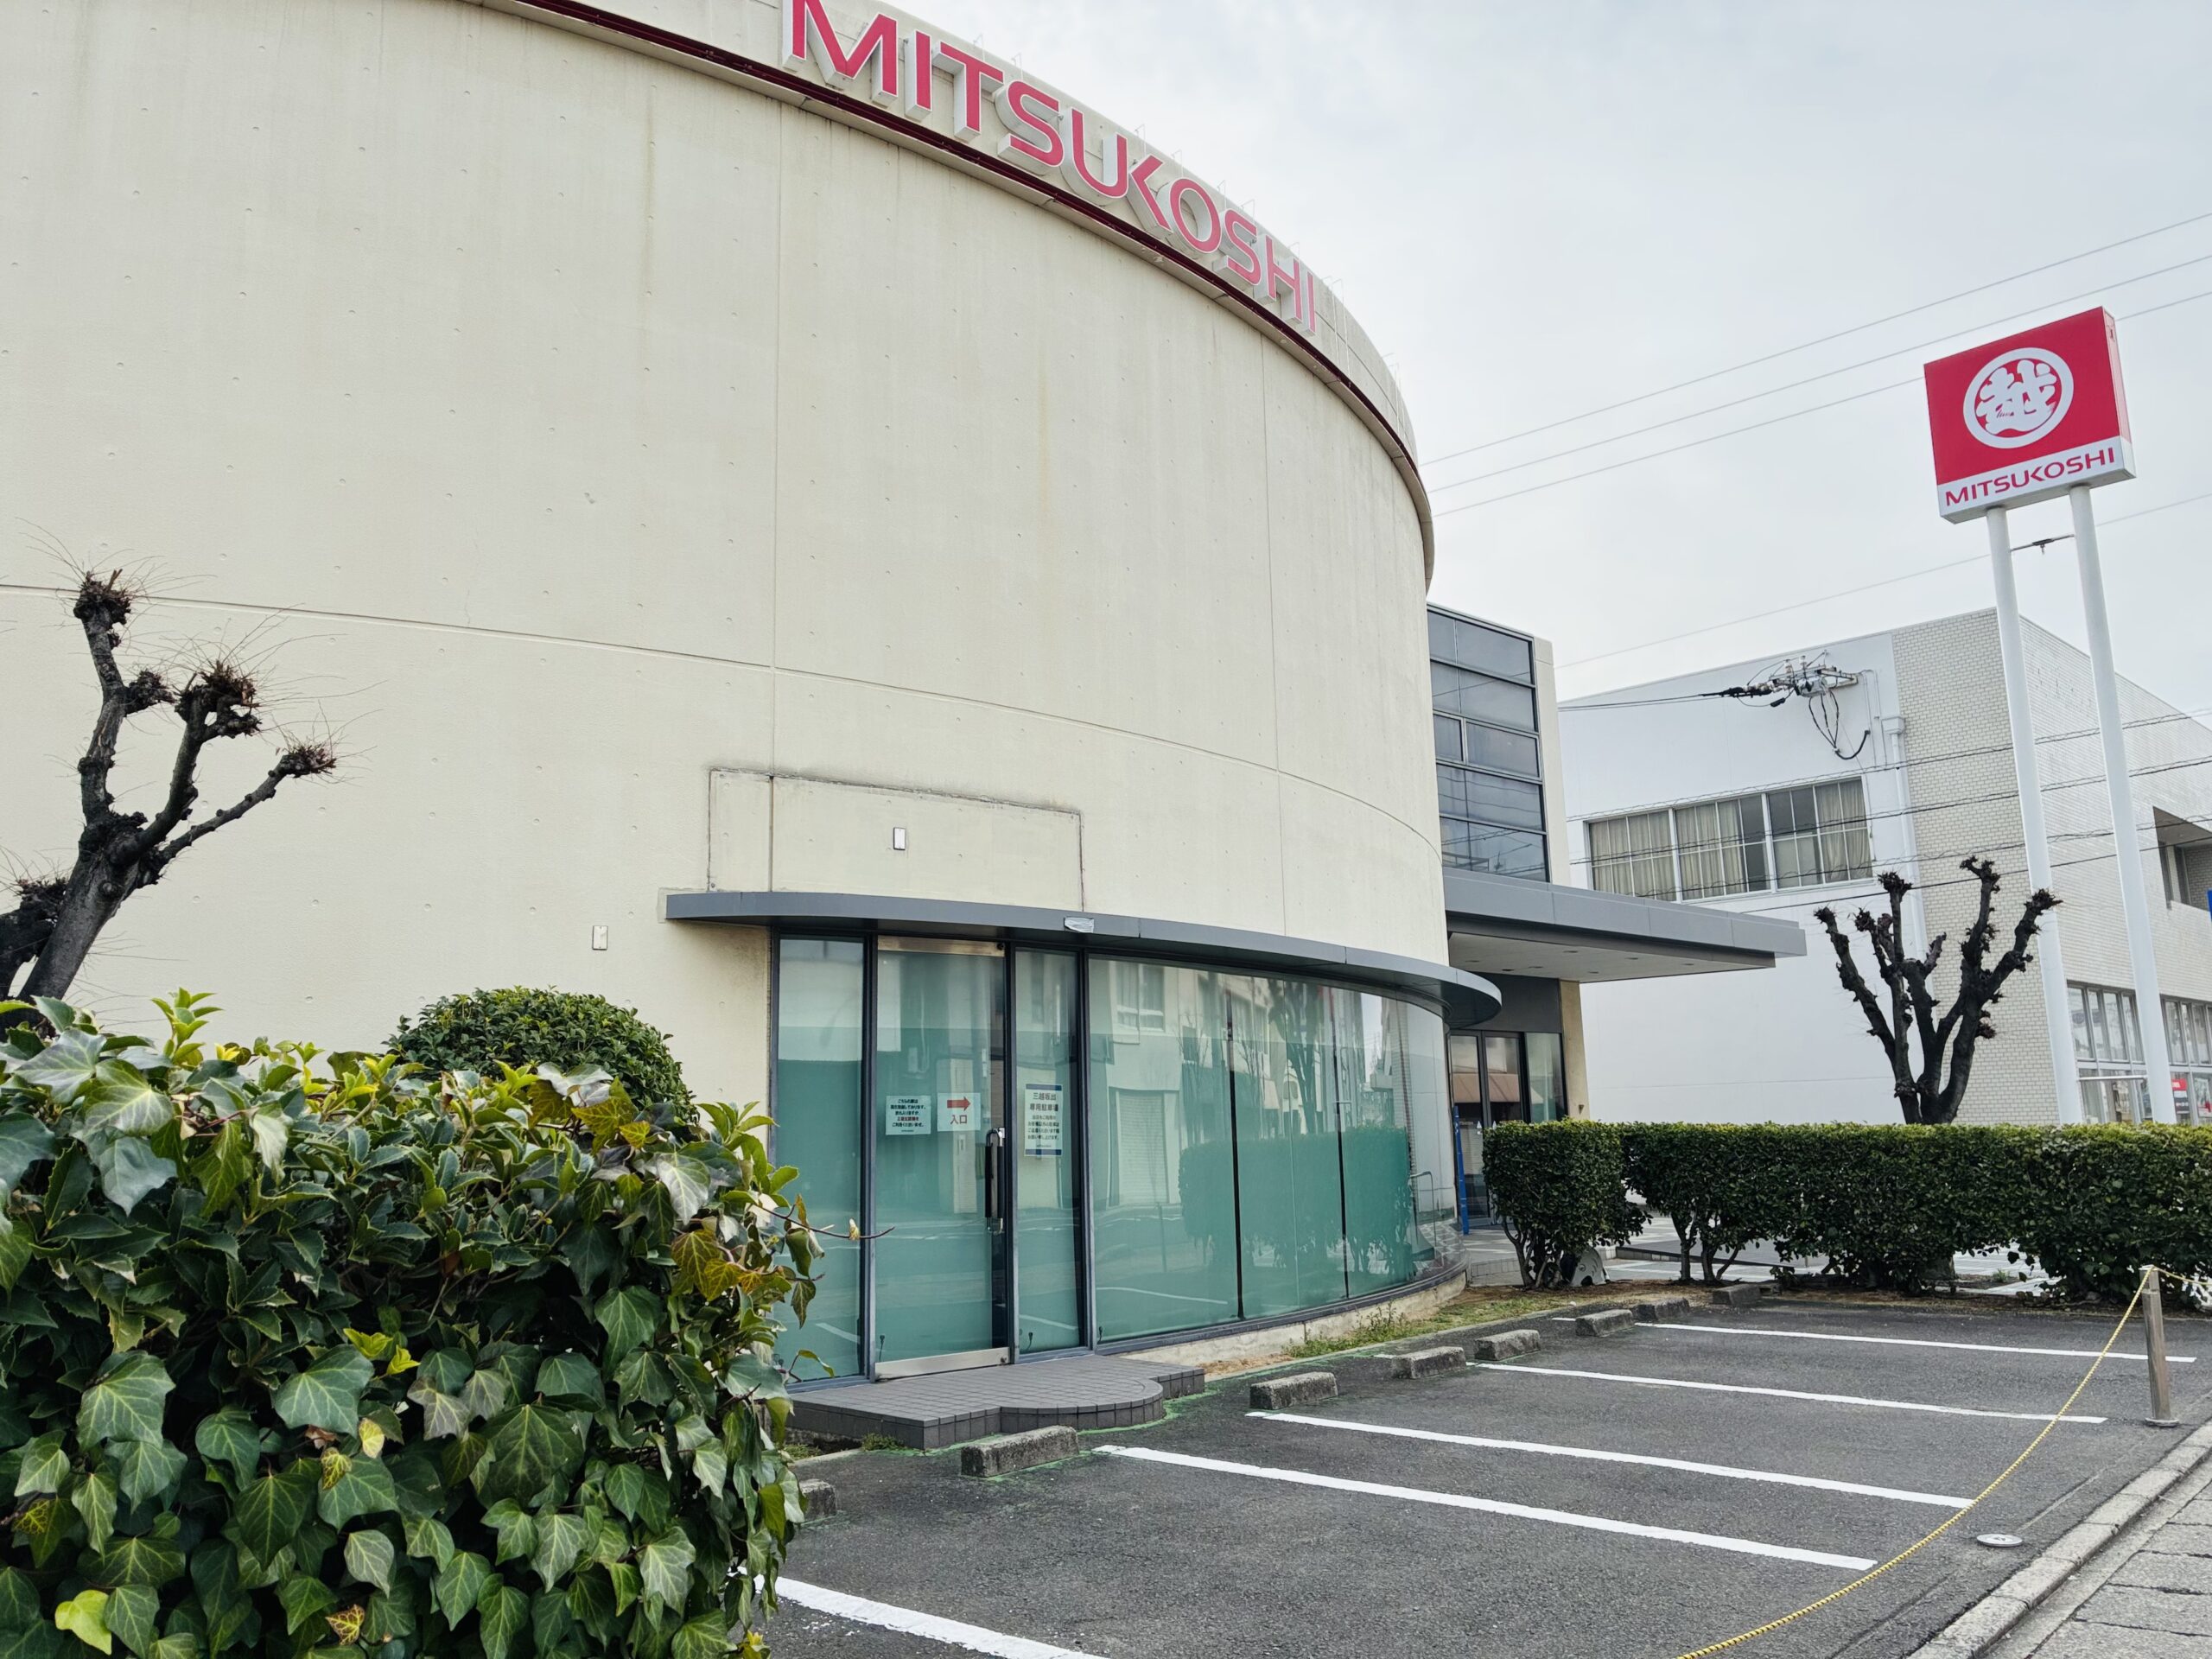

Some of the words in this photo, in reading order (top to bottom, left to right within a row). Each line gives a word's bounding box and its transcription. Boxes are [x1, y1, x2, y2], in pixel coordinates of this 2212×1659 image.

[785, 0, 1316, 336] MITSUKOSHI
[1945, 447, 2115, 506] MITSUKOSHI
[950, 1114, 968, 1125] 入口
